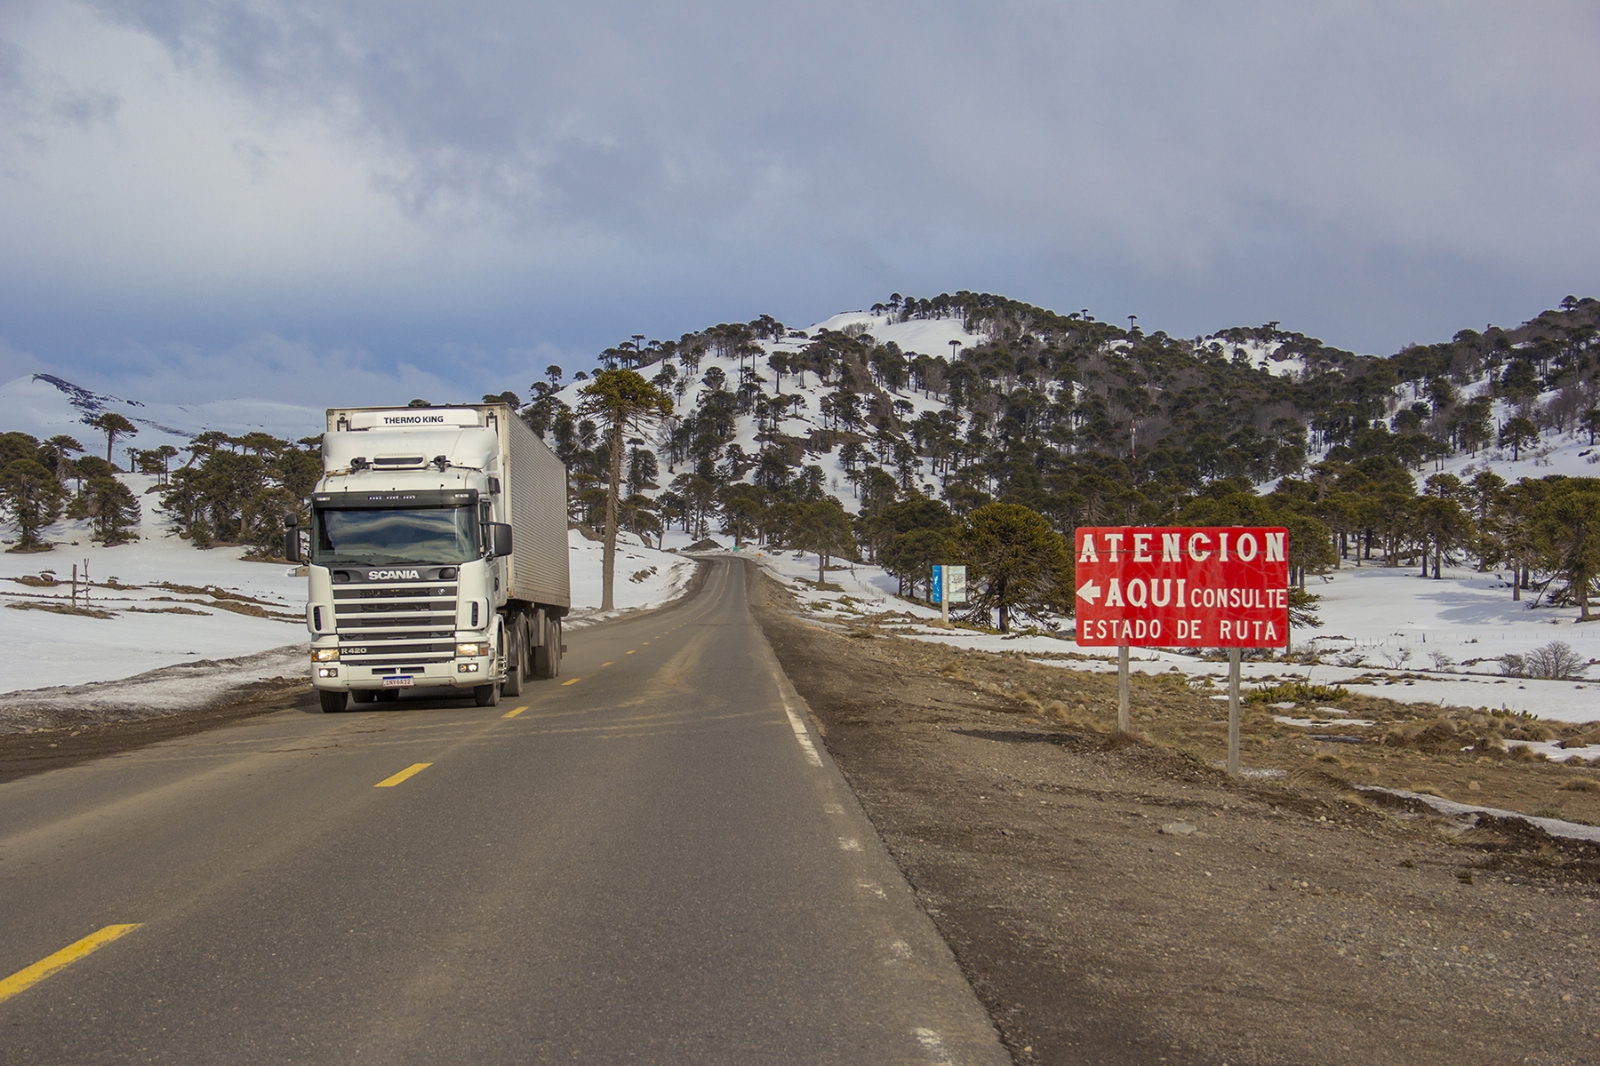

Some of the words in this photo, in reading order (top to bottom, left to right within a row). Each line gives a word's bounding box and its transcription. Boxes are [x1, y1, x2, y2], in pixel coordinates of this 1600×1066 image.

[384, 416, 421, 424] THERMO
[1078, 532, 1285, 563] ATENCION
[368, 570, 420, 580] SCANIA
[1104, 578, 1186, 609] AQUI
[1190, 588, 1287, 609] CONSULTE
[1083, 619, 1162, 640] ESTADO
[1177, 619, 1202, 640] DE
[1220, 620, 1277, 640] RUTA
